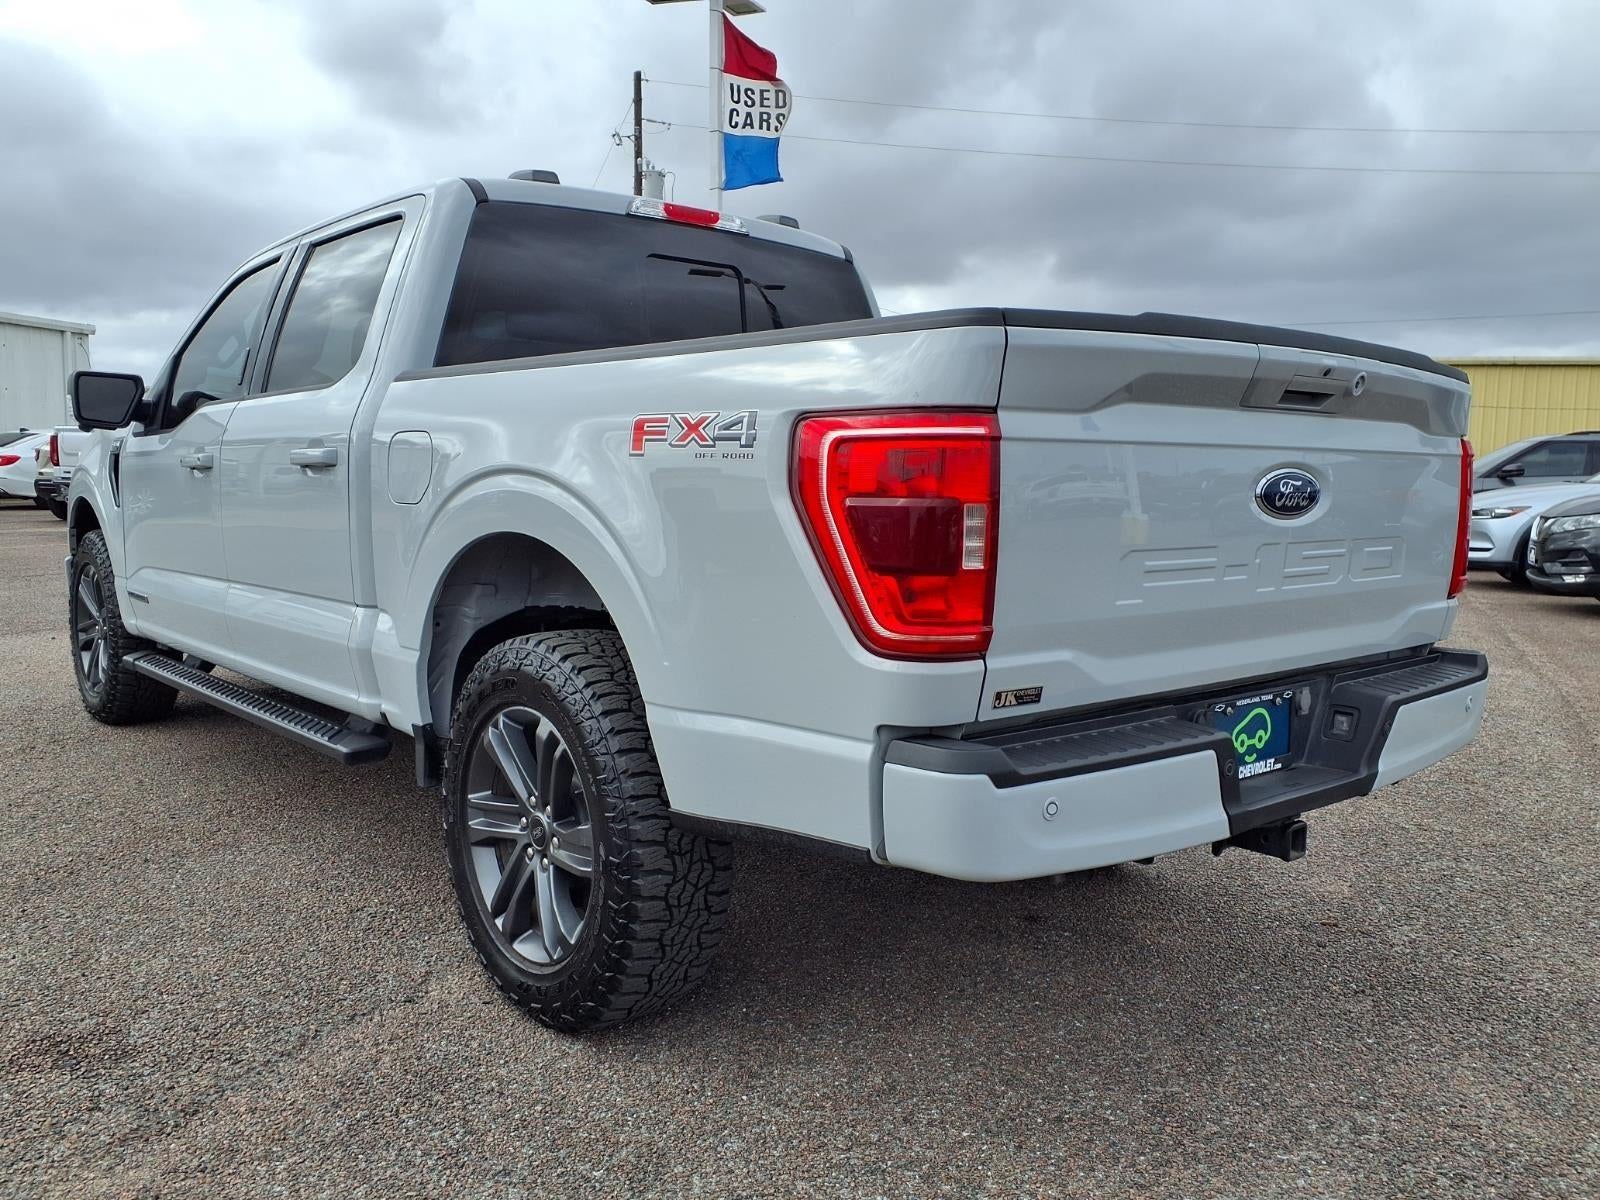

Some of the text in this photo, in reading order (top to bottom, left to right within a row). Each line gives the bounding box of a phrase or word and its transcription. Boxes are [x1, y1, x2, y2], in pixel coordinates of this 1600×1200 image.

[729, 83, 787, 109] USED
[728, 107, 786, 133] CARS
[629, 410, 759, 457] FX4
[722, 452, 754, 460] ROAD
[1275, 478, 1311, 508] Ford
[1115, 535, 1405, 605] F-150
[994, 691, 1018, 707] JK
